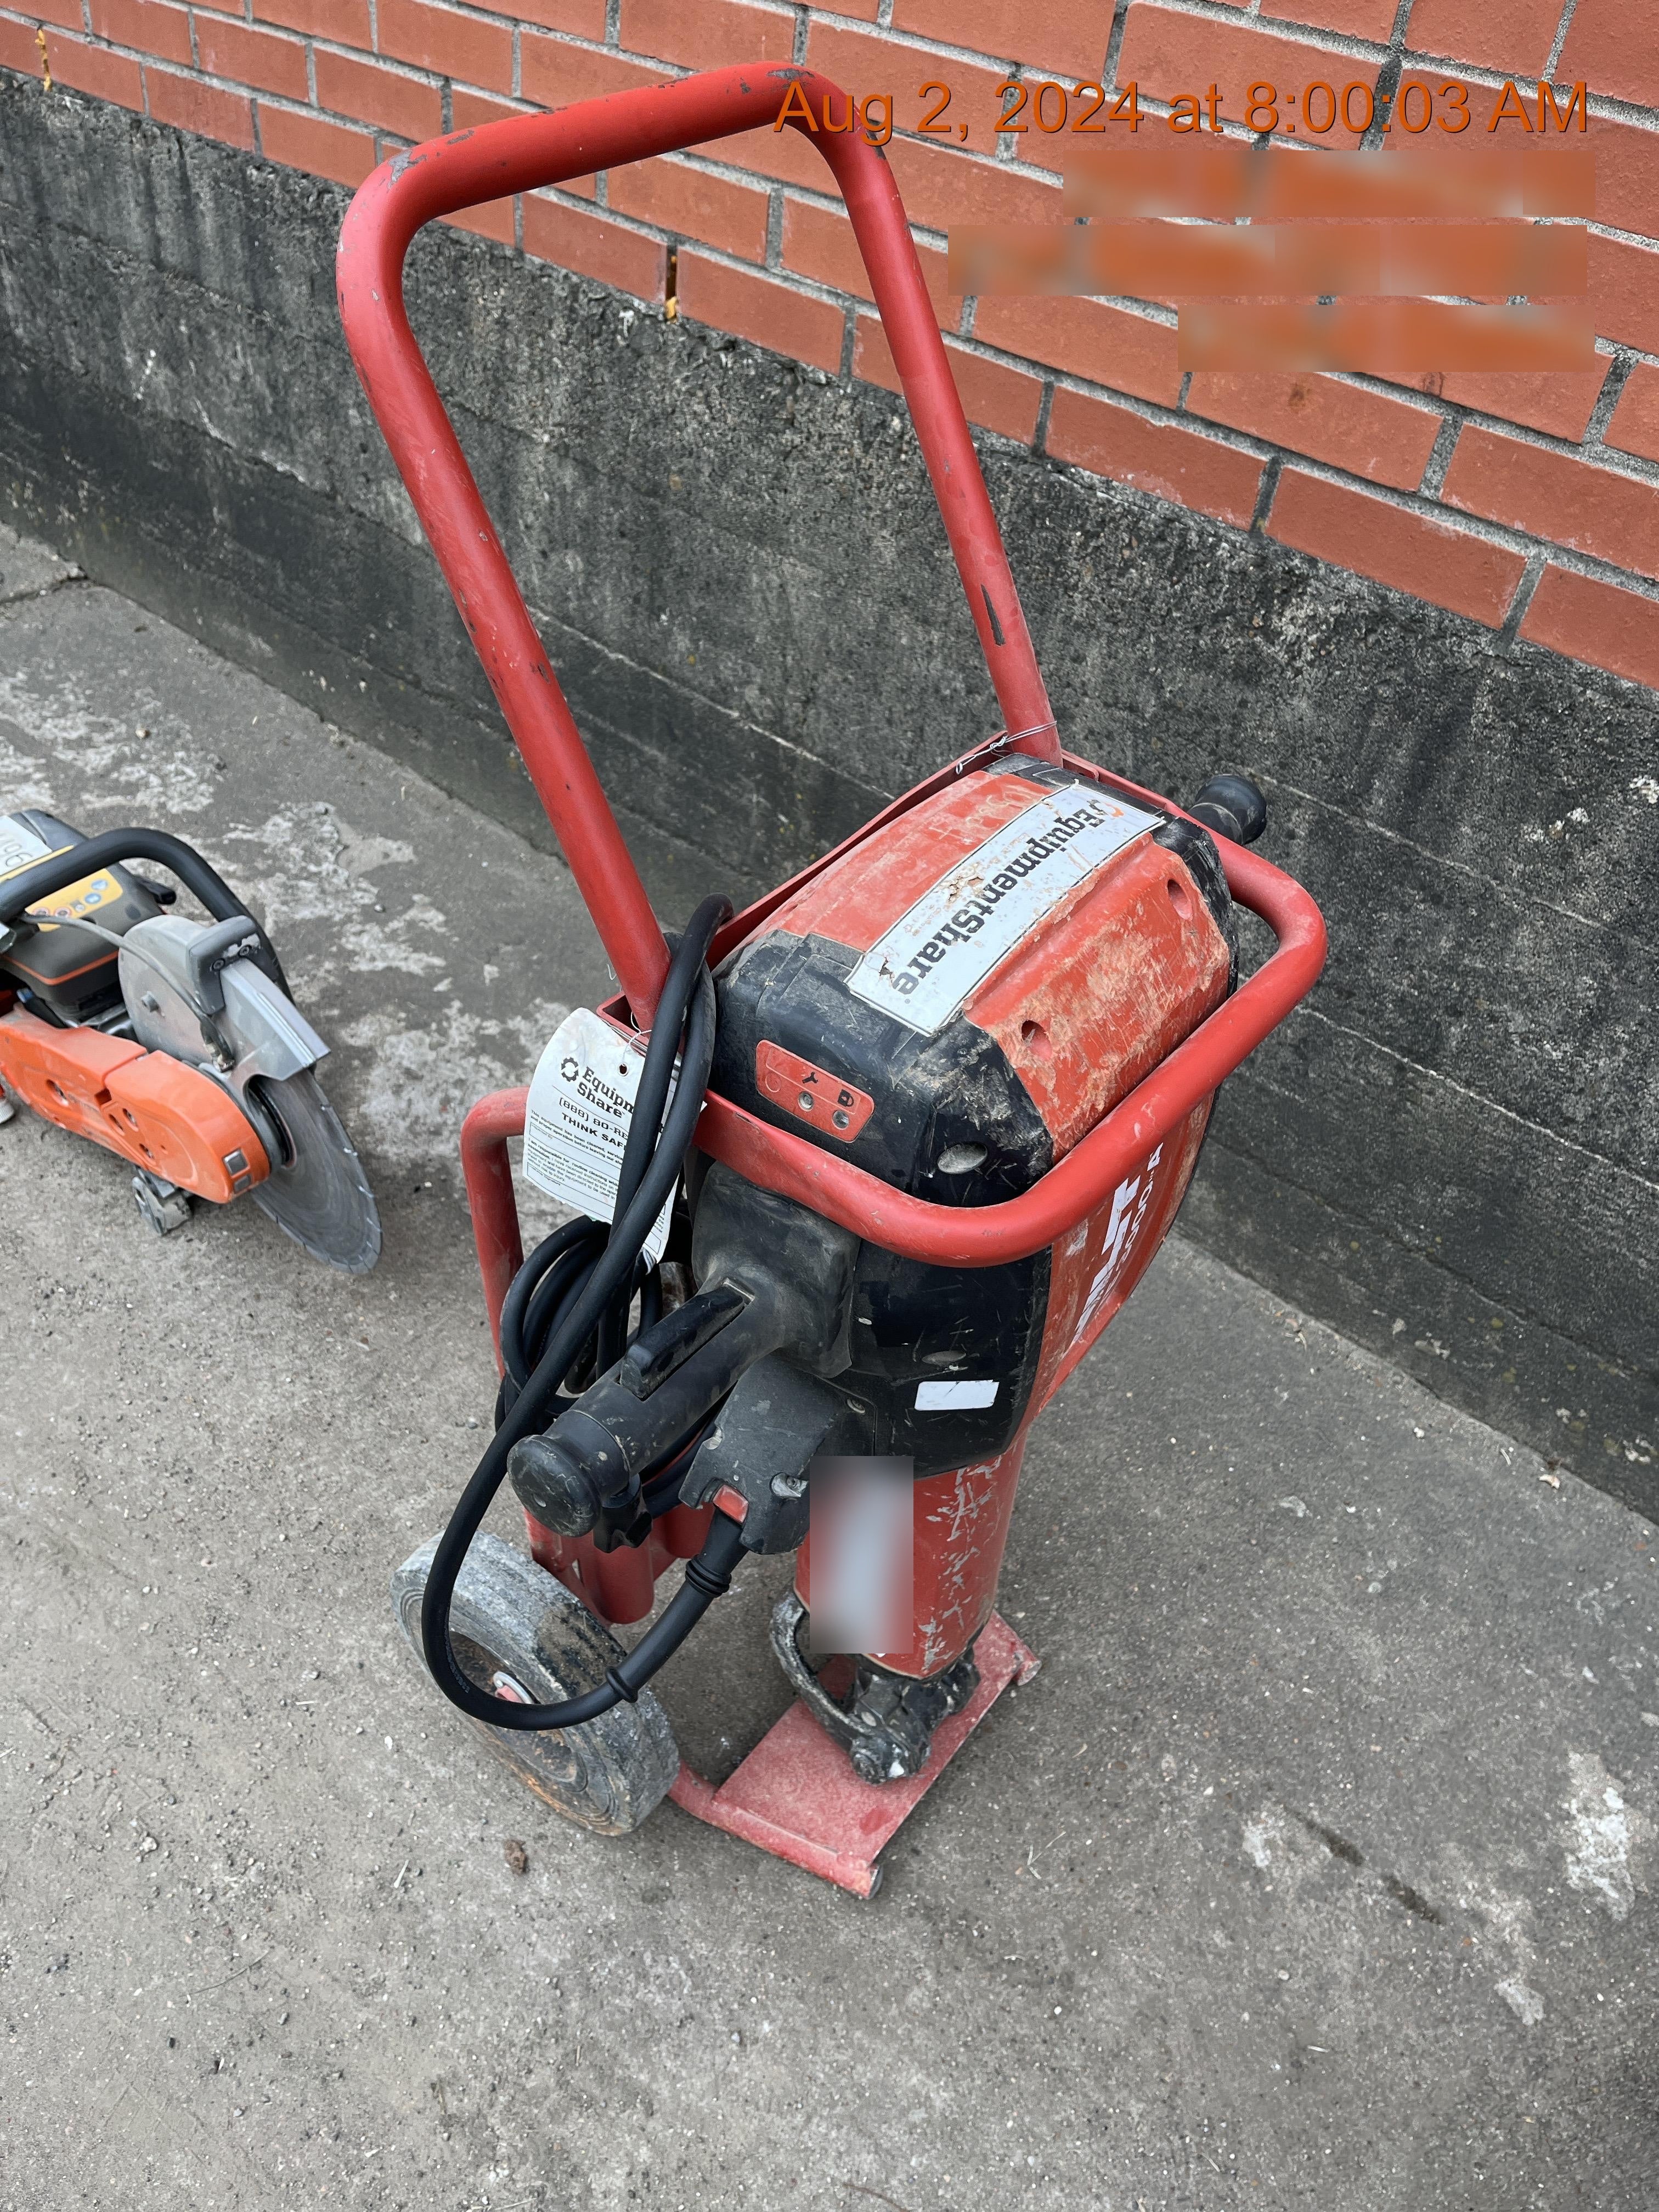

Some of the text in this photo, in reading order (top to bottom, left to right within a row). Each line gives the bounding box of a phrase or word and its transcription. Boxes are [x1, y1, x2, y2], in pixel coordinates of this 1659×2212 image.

[893, 809, 1105, 995] EquipmentShare
[577, 1081, 622, 1118] Share
[562, 1112, 598, 1137] THINK
[601, 1133, 626, 1150] SAF
[593, 1118, 628, 1140] 80-RE
[607, 1151, 623, 1160] service
